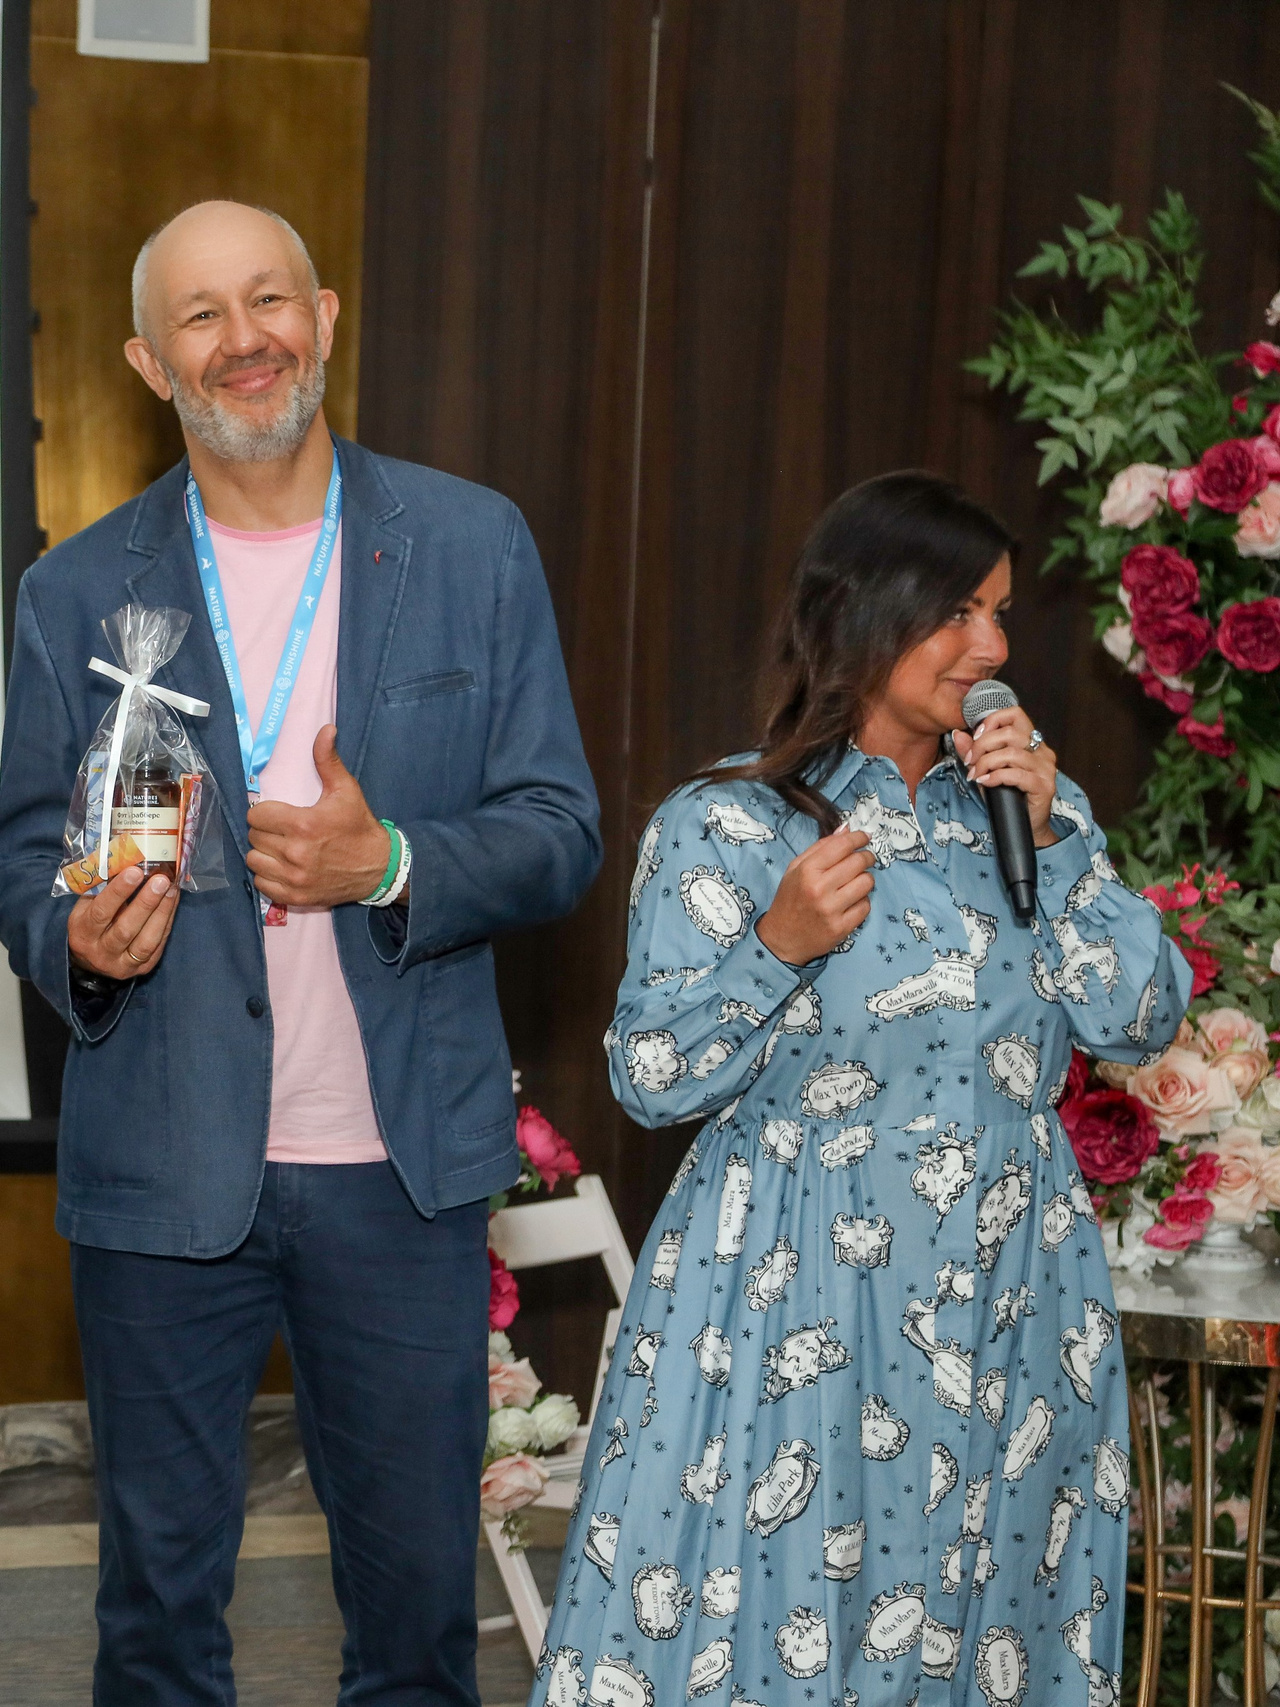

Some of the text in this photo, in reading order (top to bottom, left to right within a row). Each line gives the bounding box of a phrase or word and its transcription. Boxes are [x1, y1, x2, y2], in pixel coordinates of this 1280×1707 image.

[329, 474, 343, 519] SUNSHINE
[189, 494, 204, 539] SUNSHINE
[313, 534, 332, 577] NATURES
[208, 586, 236, 689] NATURES SUNSHINE
[284, 628, 304, 677] SUNSHINE
[265, 691, 285, 736] NATURES
[127, 811, 160, 819] раберс
[886, 996, 904, 1008] Max
[903, 989, 923, 1001] Mara
[938, 971, 975, 988] AX TOW
[830, 1078, 862, 1096] Town
[1000, 1046, 1035, 1093] Max Town
[723, 1190, 735, 1228] Max Mara
[767, 1491, 784, 1514] Lilia
[778, 1468, 802, 1494] Park
[1098, 1464, 1118, 1497] Town
[651, 1582, 661, 1626] TEDDY TOWN
[878, 1607, 917, 1638] Max Mara
[923, 1637, 945, 1655] MARA
[701, 1659, 719, 1674] ville
[999, 1650, 1009, 1691] Max Mara
[557, 1670, 567, 1704] Max Mara
[599, 1676, 634, 1699] Max Mara
